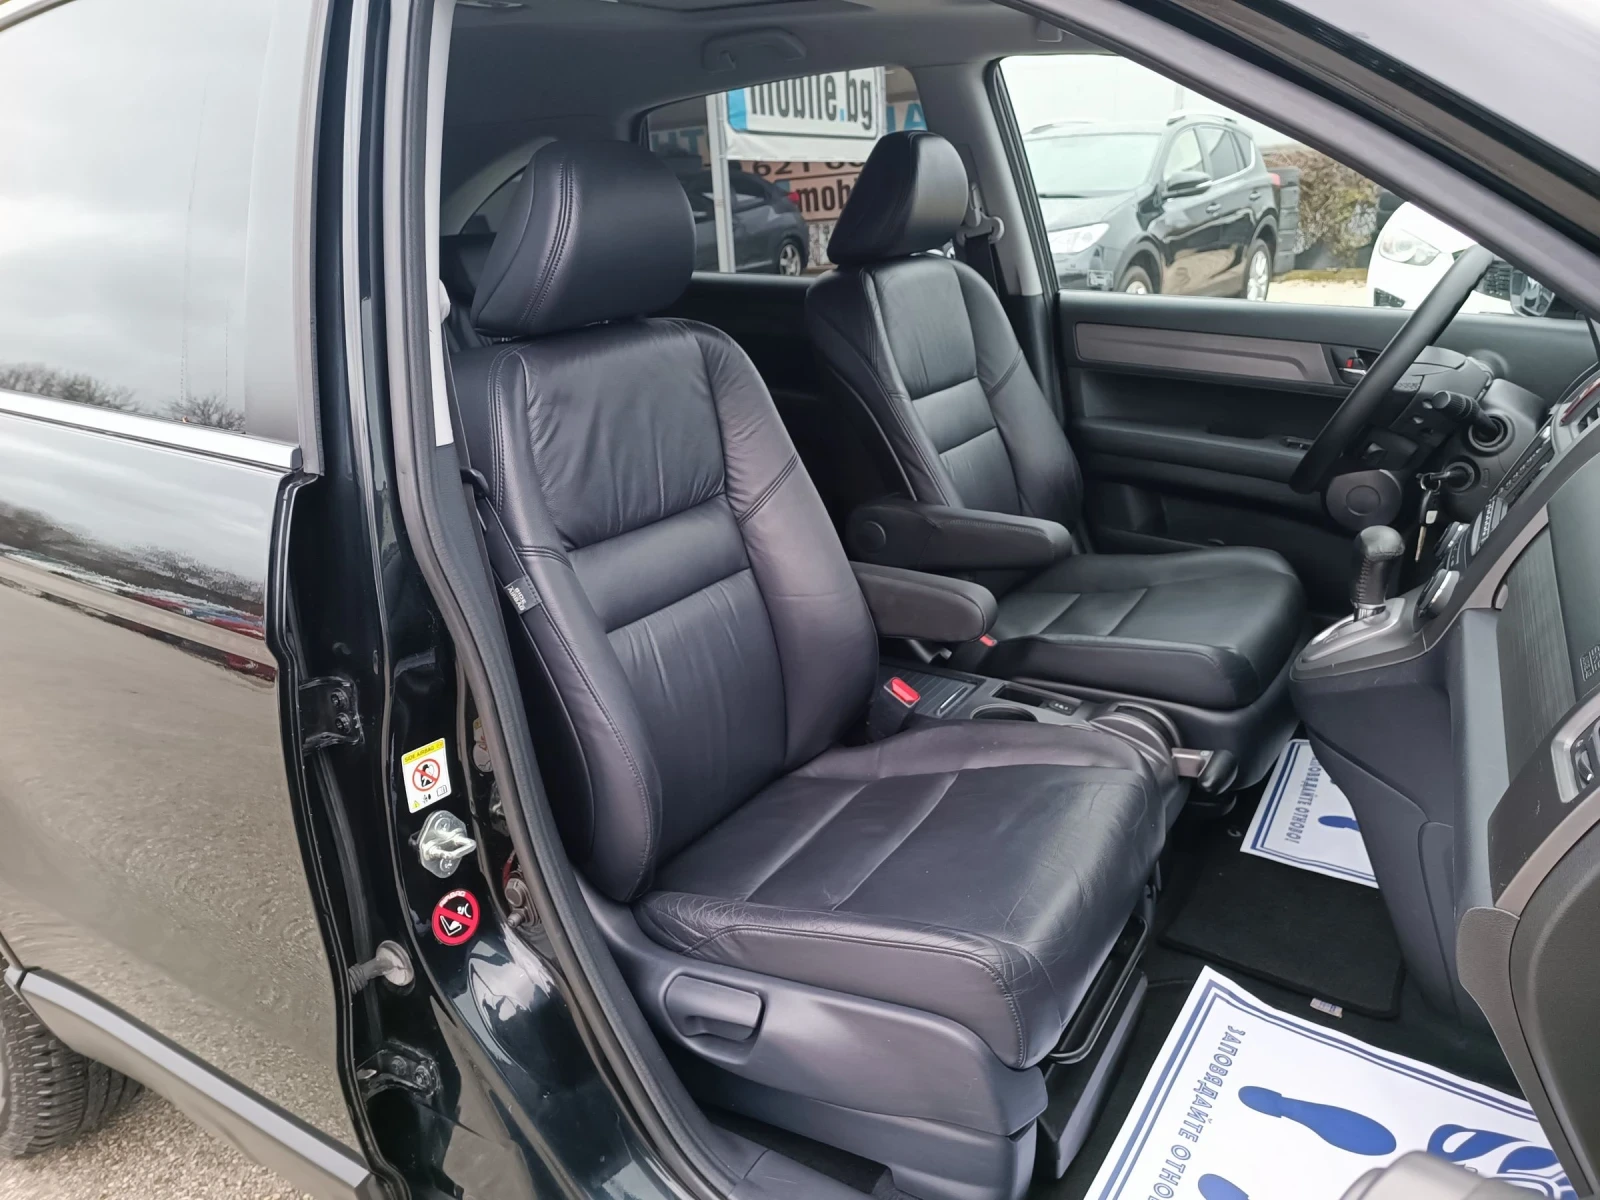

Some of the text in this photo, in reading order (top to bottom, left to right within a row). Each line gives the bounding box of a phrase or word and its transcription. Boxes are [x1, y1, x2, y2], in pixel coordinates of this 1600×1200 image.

[416, 745, 435, 758] AIRBAG
[1147, 1025, 1246, 1200] ЗАПОВЯДАЙТЕ ОТНО
